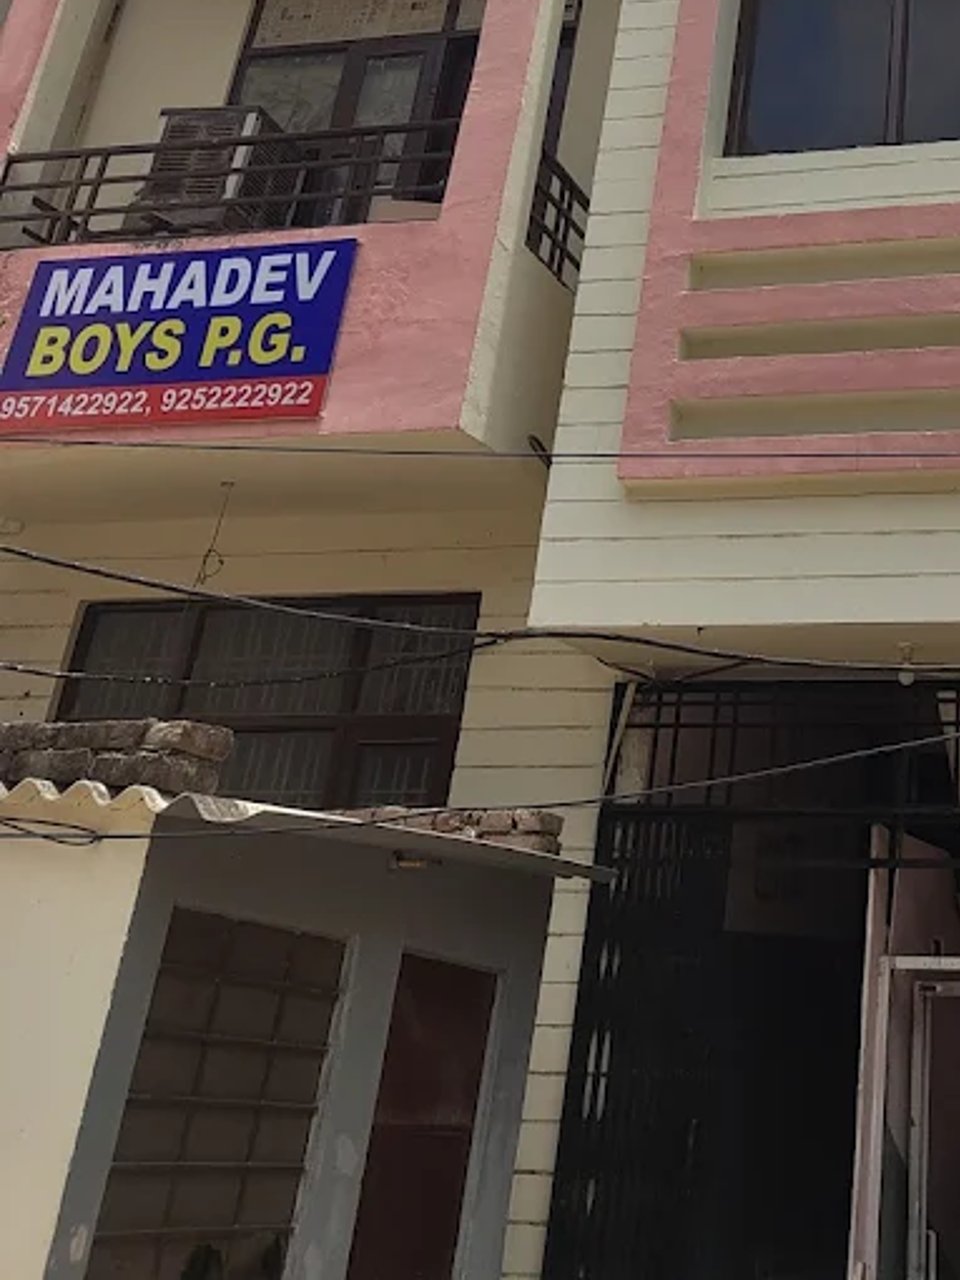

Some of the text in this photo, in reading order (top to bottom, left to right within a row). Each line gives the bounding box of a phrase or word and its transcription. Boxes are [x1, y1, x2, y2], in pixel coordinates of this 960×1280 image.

[40, 251, 336, 317] MAHADEV
[25, 312, 305, 377] BOYS P.G.
[0, 381, 313, 419] 9571422922, 9252222922
